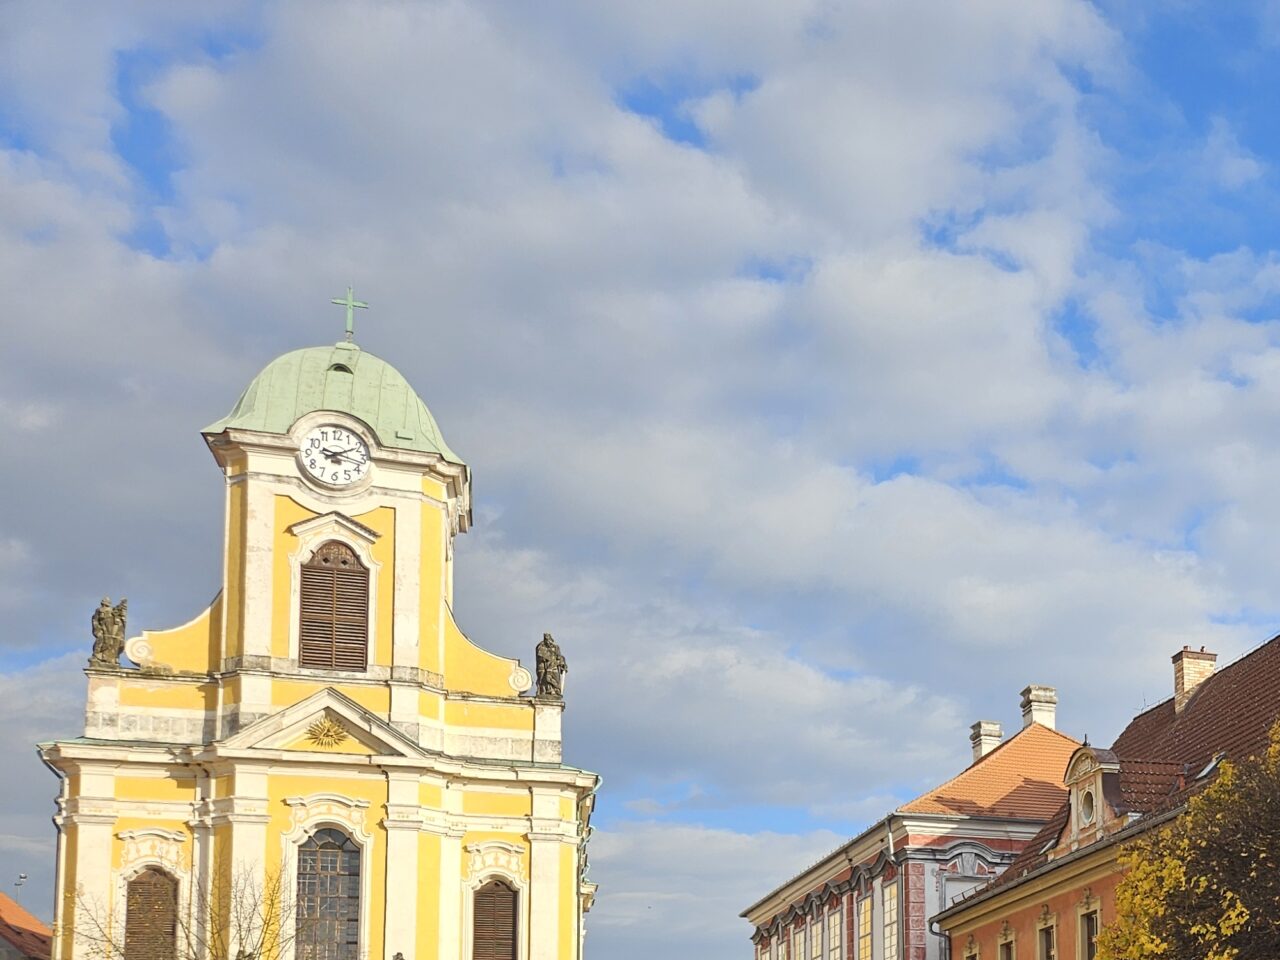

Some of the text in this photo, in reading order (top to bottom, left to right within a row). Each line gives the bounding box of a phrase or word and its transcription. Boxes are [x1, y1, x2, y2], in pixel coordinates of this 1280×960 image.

[321, 431, 328, 442] 11
[332, 430, 342, 441] 12
[346, 435, 350, 445] 1
[310, 438, 320, 449] 10
[355, 442, 362, 453] 2
[305, 448, 312, 458] 9
[309, 459, 316, 469] 8
[360, 454, 367, 465] 3
[319, 467, 326, 477] 7
[353, 464, 361, 475] 4
[331, 472, 338, 481] 6
[344, 470, 351, 481] 5
